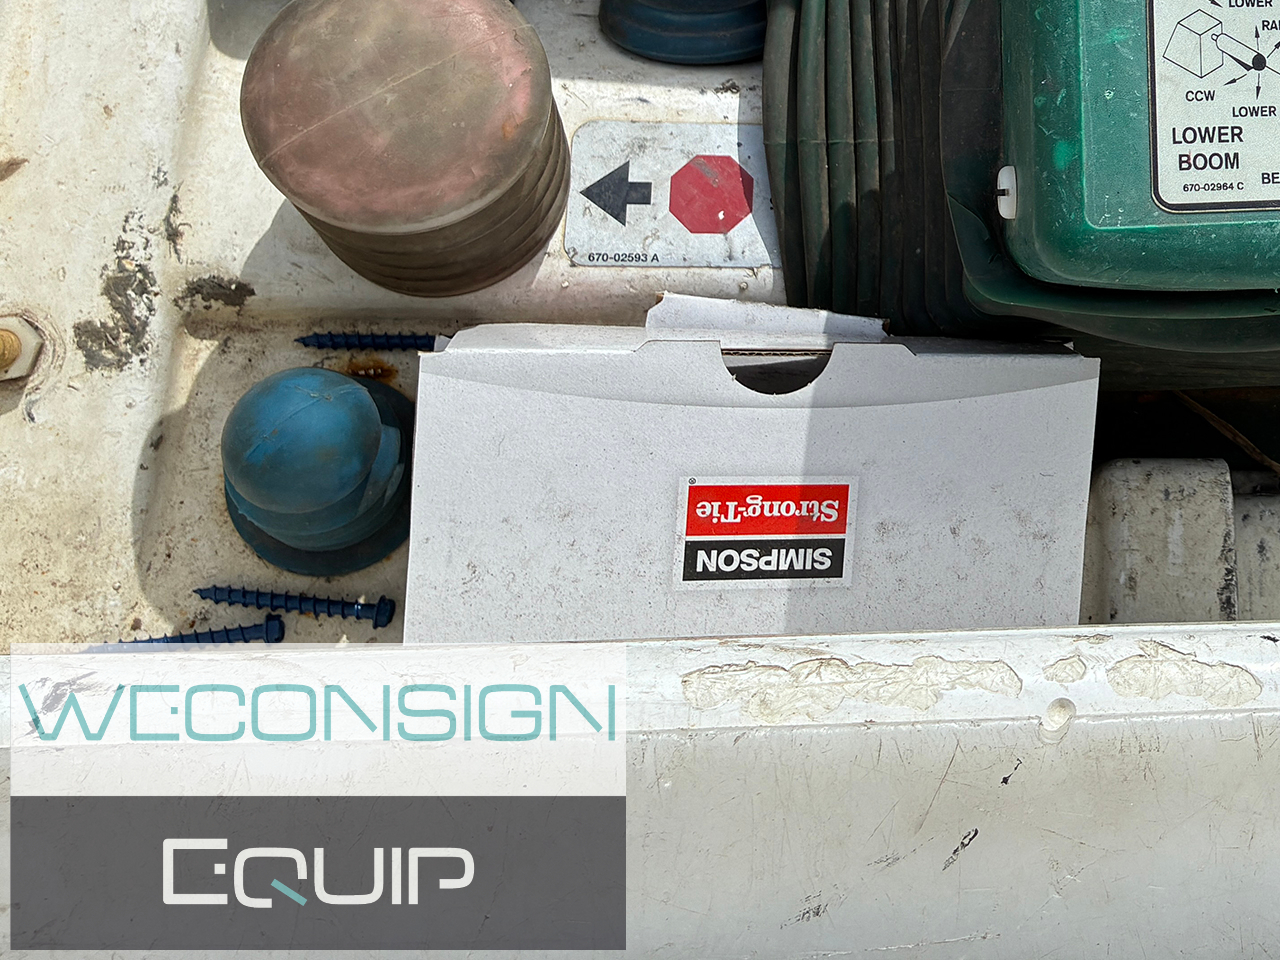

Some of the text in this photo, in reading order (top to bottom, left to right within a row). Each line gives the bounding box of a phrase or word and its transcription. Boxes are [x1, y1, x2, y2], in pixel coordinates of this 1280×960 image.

[1185, 90, 1215, 101] CCW
[1232, 106, 1276, 117] LOWER
[1172, 126, 1244, 144] LOWER
[1179, 152, 1239, 171] BOOM
[1183, 182, 1244, 192] 670-02964 C
[588, 253, 659, 262] 670-02593 A
[696, 495, 839, 523] Strong-Tie
[696, 548, 833, 572] SIMPSON
